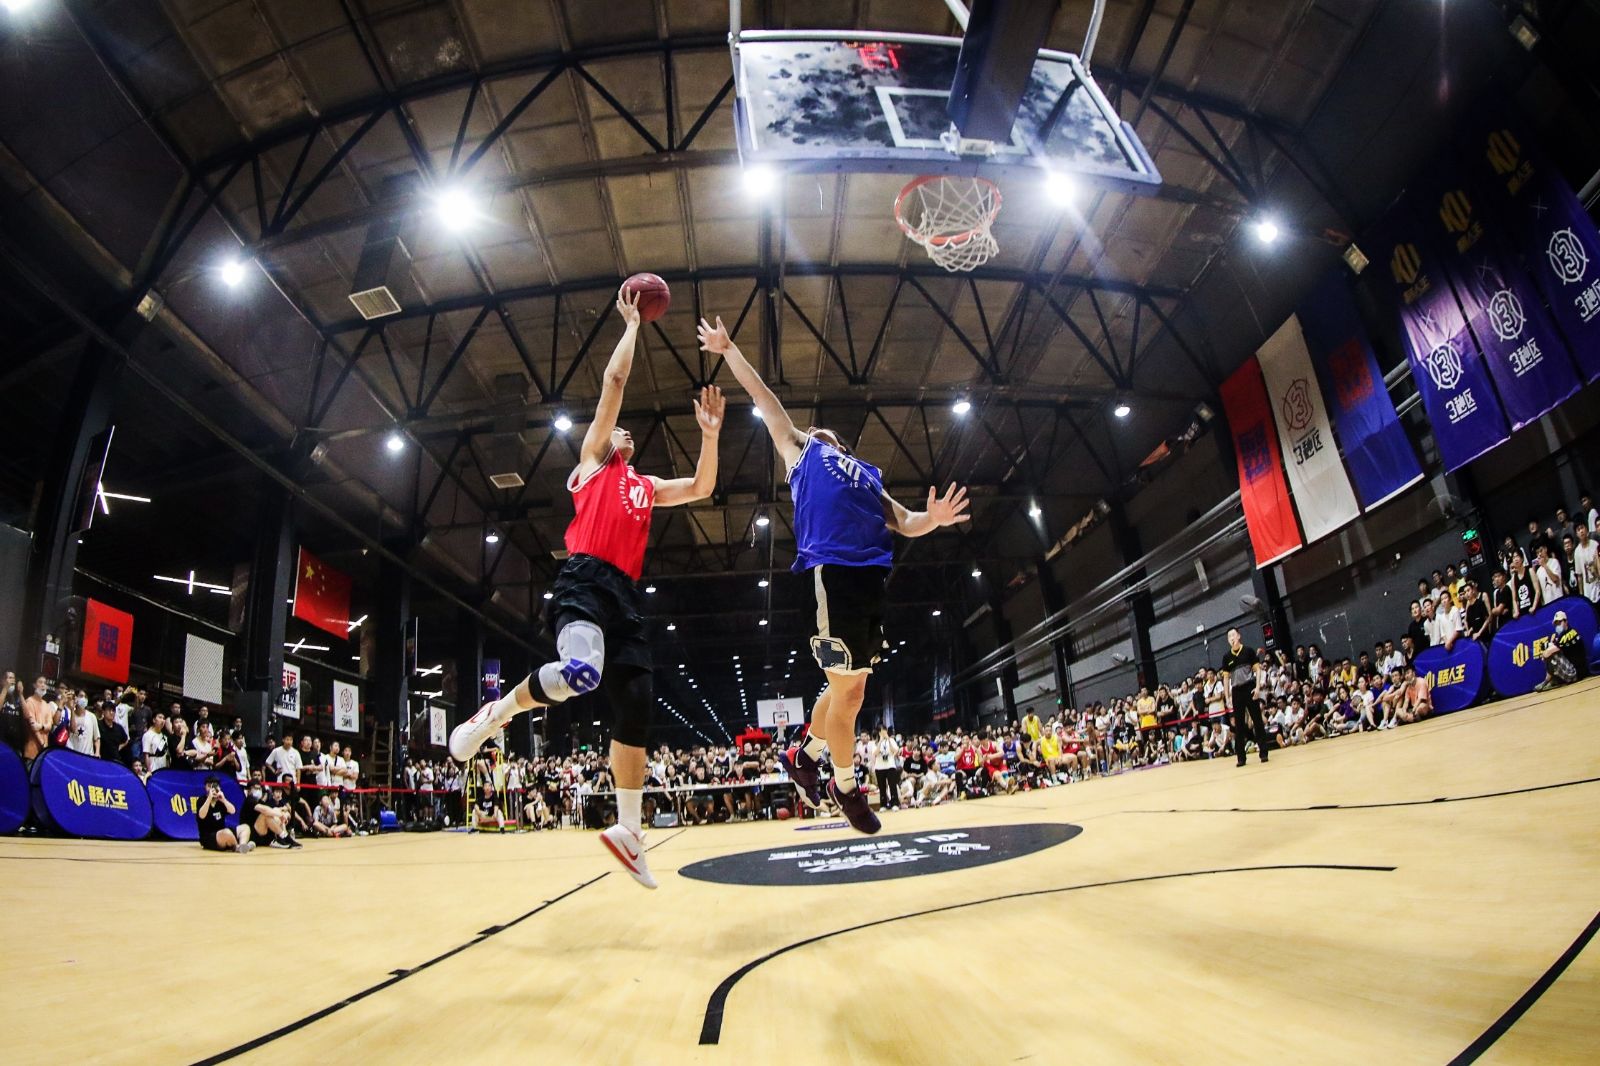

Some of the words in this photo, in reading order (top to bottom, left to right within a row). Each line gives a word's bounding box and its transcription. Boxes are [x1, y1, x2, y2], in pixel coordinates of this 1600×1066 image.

[1437, 664, 1466, 683] 路人王
[88, 785, 128, 806] 路人王
